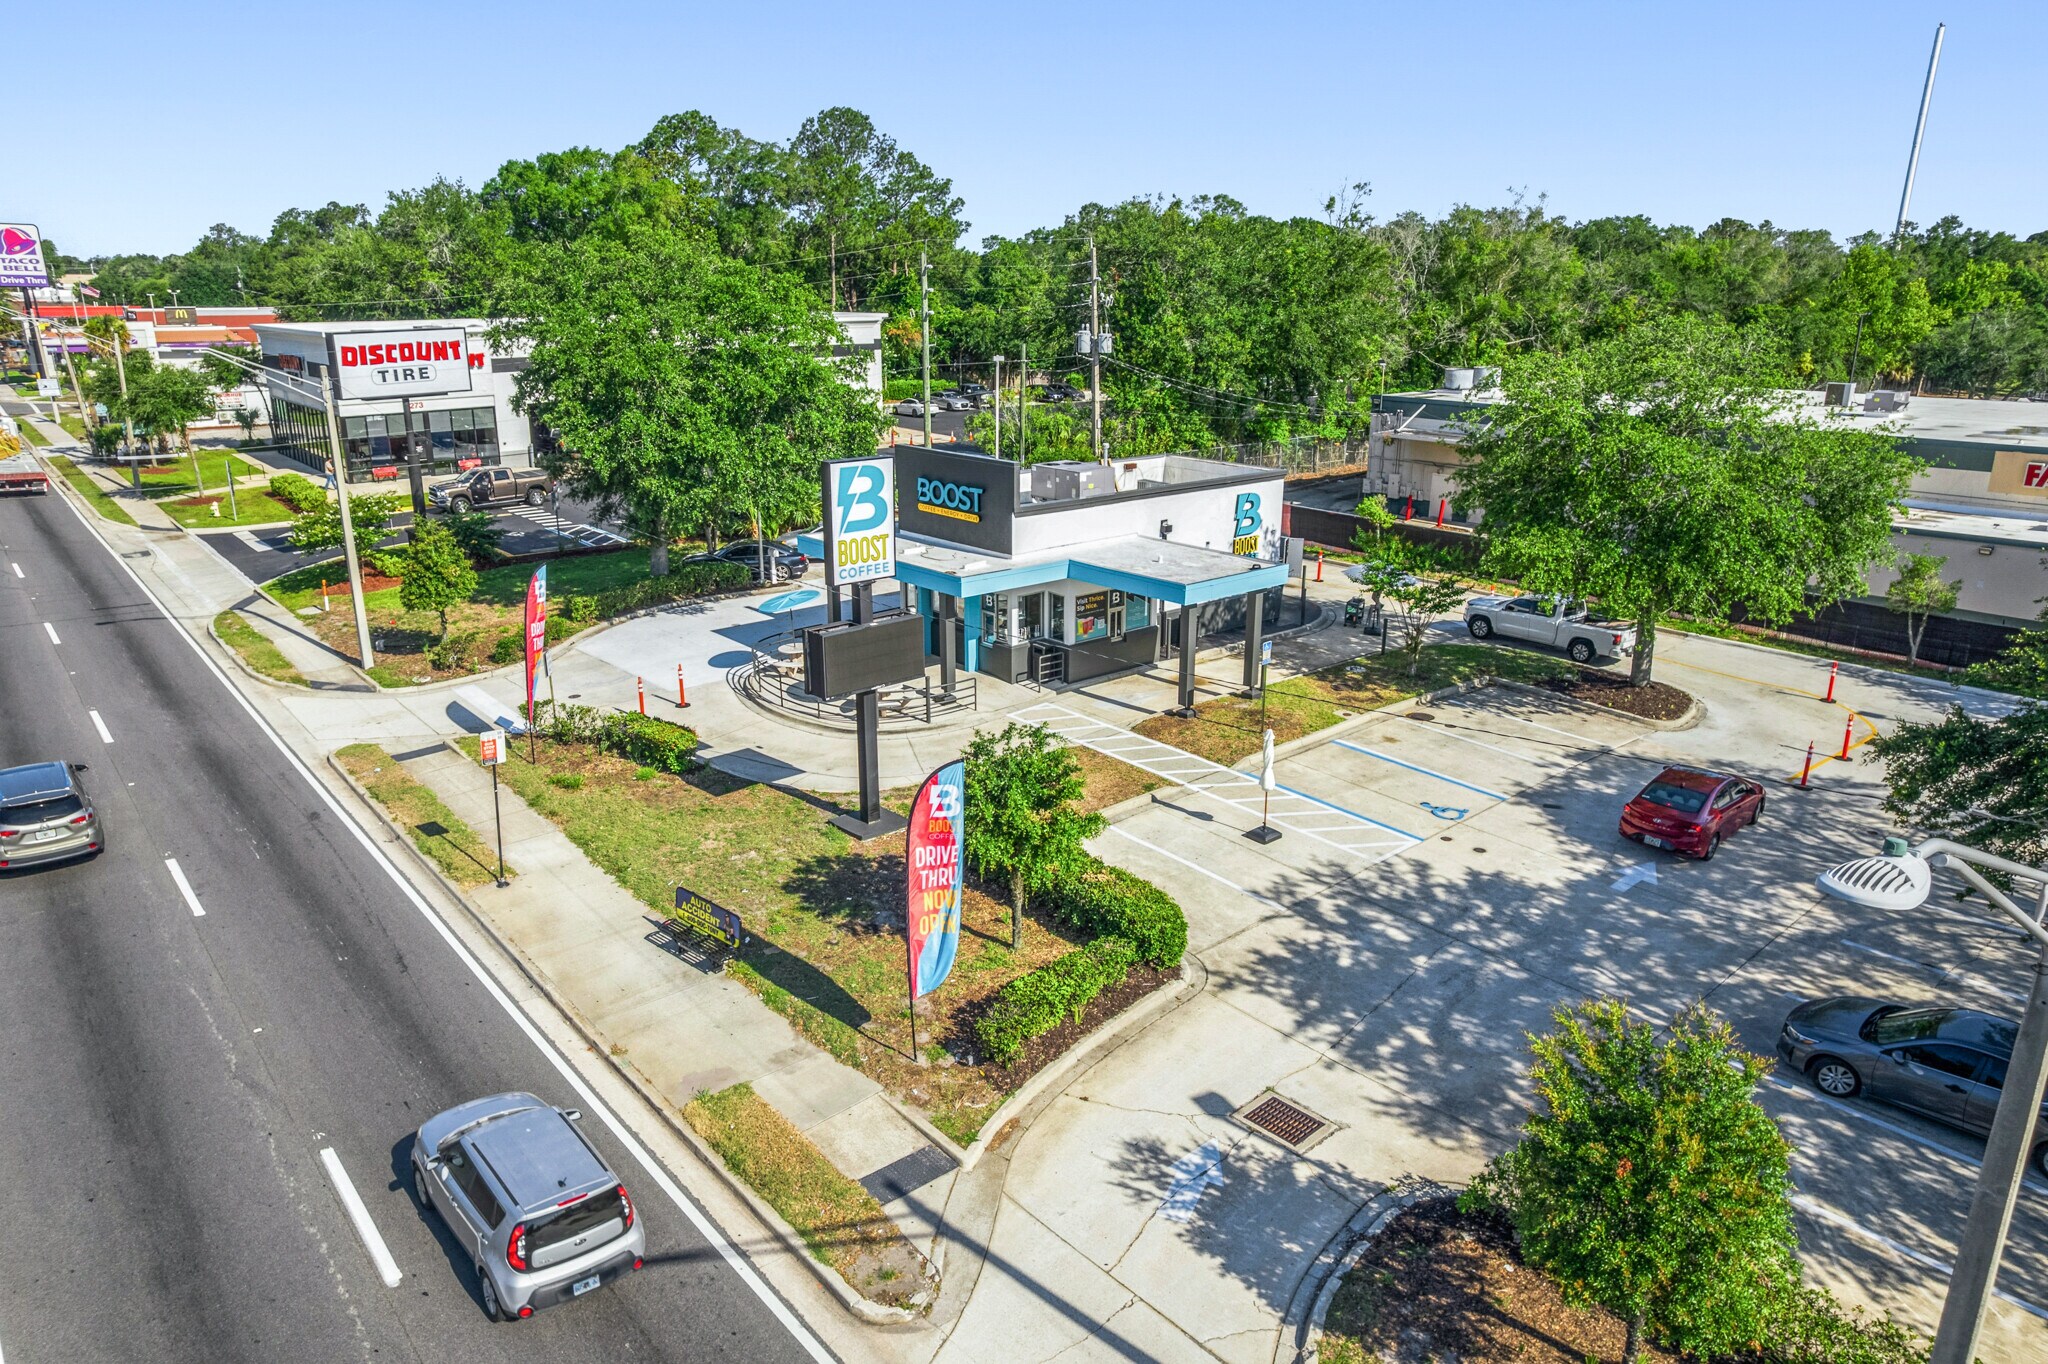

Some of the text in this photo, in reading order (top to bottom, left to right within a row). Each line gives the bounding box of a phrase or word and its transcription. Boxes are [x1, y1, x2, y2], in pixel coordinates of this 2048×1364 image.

[0, 276, 47, 284] Drive Thru
[340, 339, 461, 367] DISCOUNT
[377, 366, 430, 383] TIRE
[408, 402, 424, 410] 273
[917, 477, 983, 513] BOOST
[837, 533, 889, 567] BOOST
[1233, 535, 1259, 555] BOOST
[839, 562, 890, 579] COFFEE
[928, 832, 958, 840] COFFEE
[929, 819, 960, 833] BOOST
[915, 844, 959, 868] DRIVE
[919, 865, 959, 890] THRU
[691, 897, 712, 913] AUTO
[923, 888, 958, 912] NOW
[682, 901, 720, 927] ACCIDENT
[919, 912, 958, 935] OPEN
